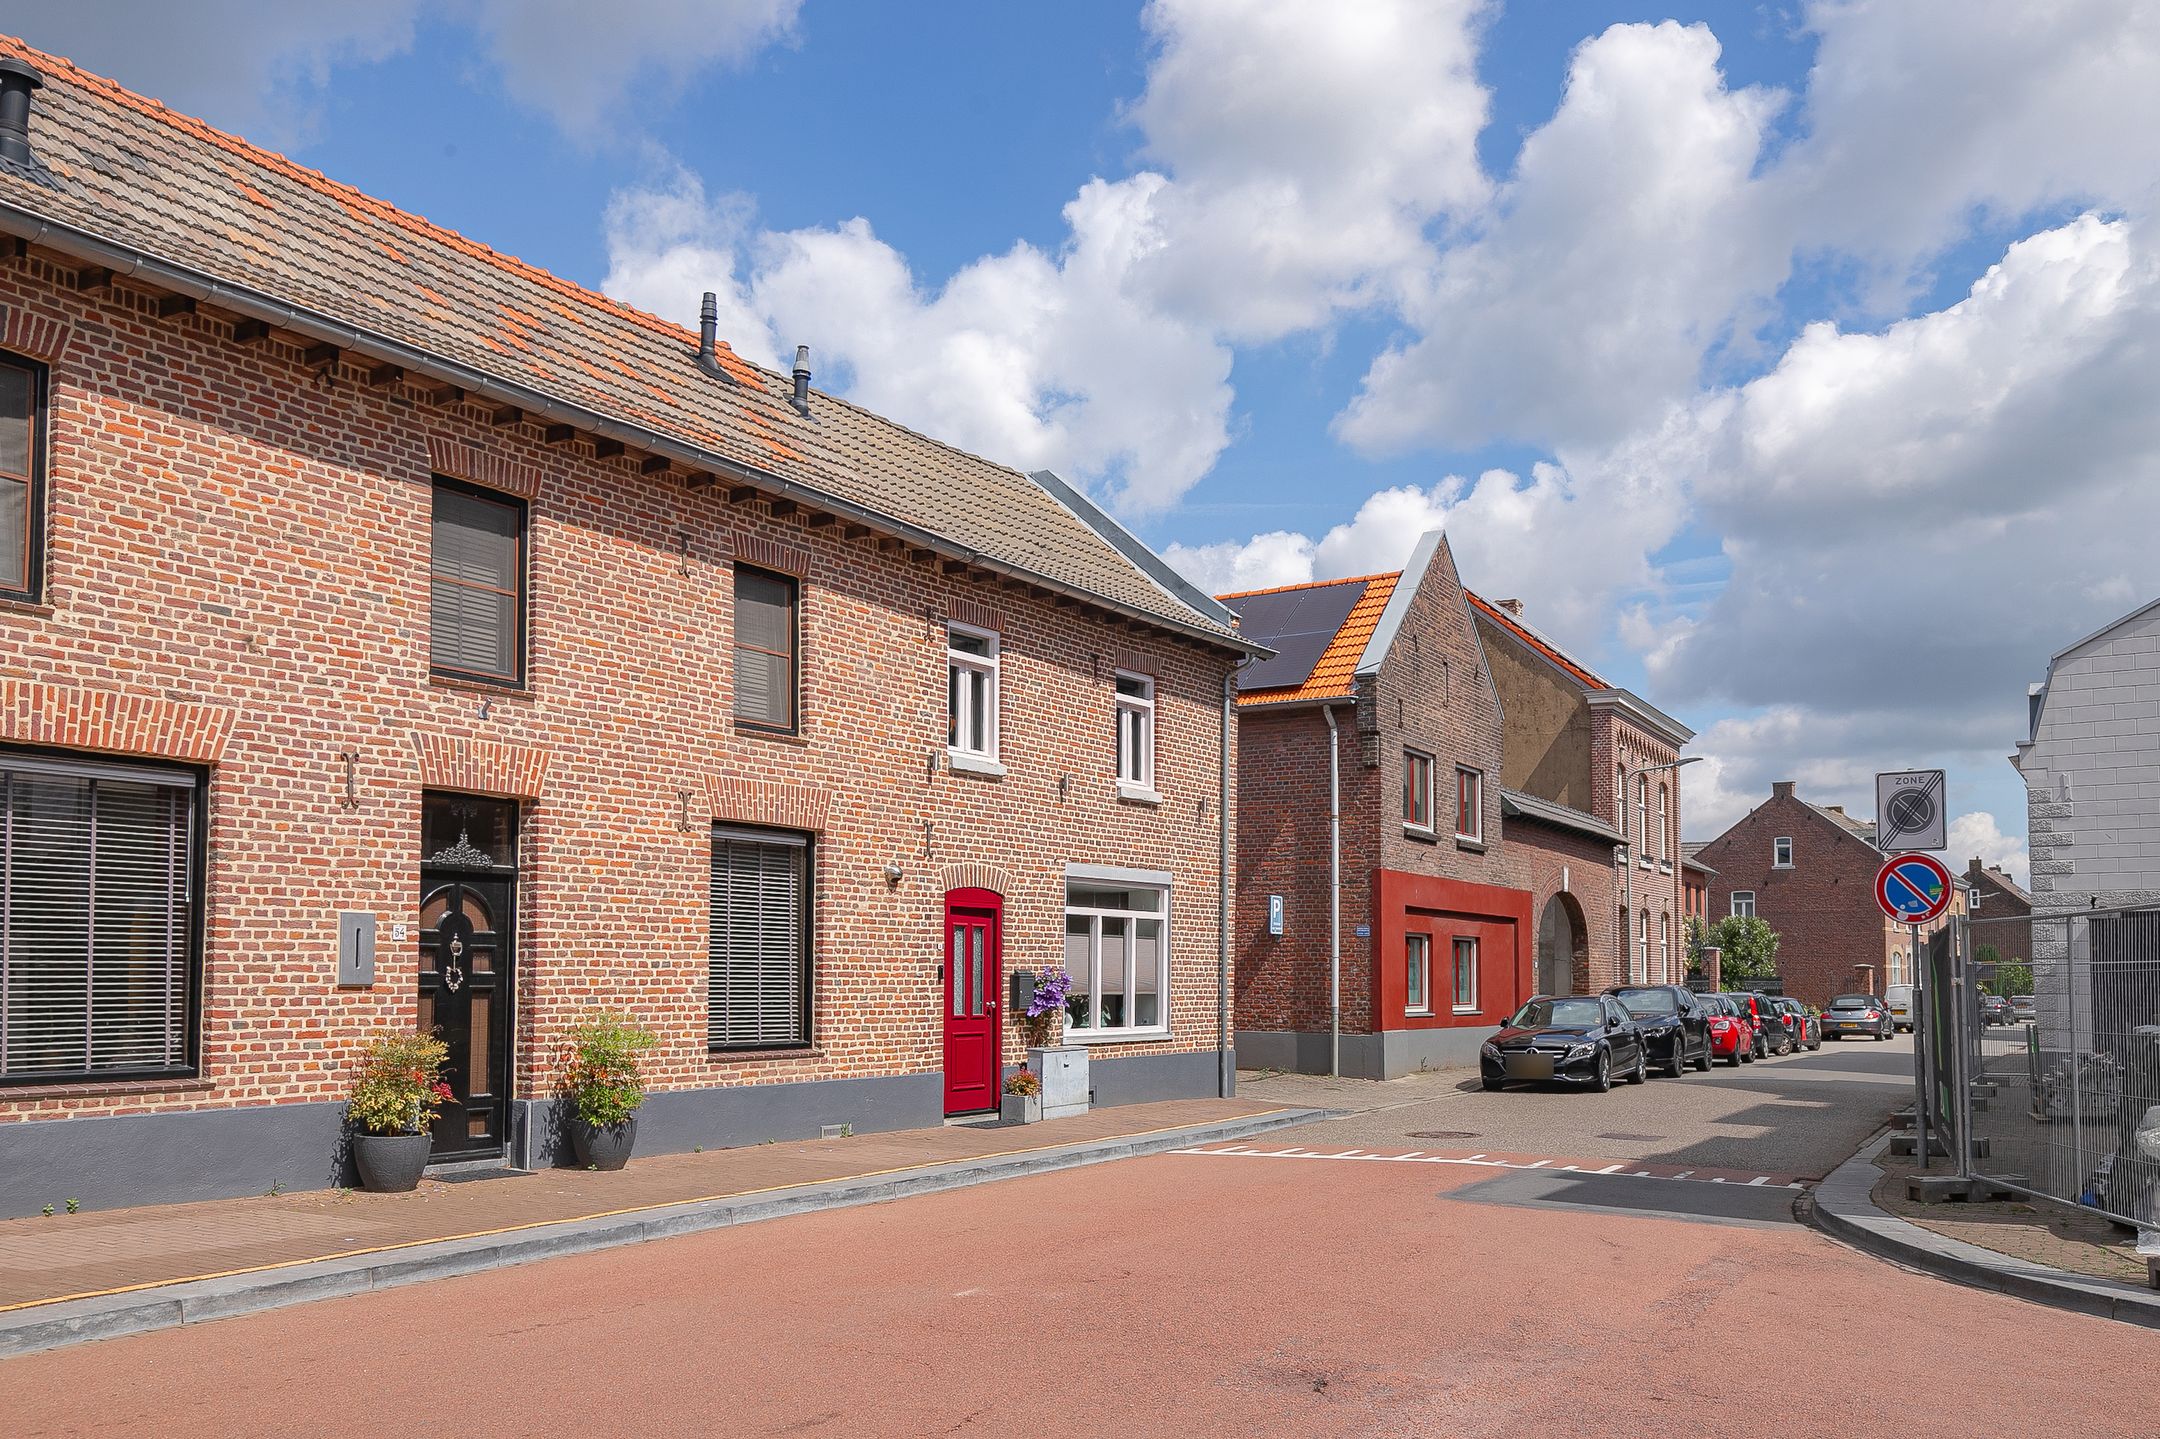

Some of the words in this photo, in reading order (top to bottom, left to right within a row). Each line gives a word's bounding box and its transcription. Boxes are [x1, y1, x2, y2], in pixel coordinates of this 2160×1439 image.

[1895, 776, 1925, 785] ZONE
[1274, 899, 1280, 918] P
[395, 928, 404, 937] 54
